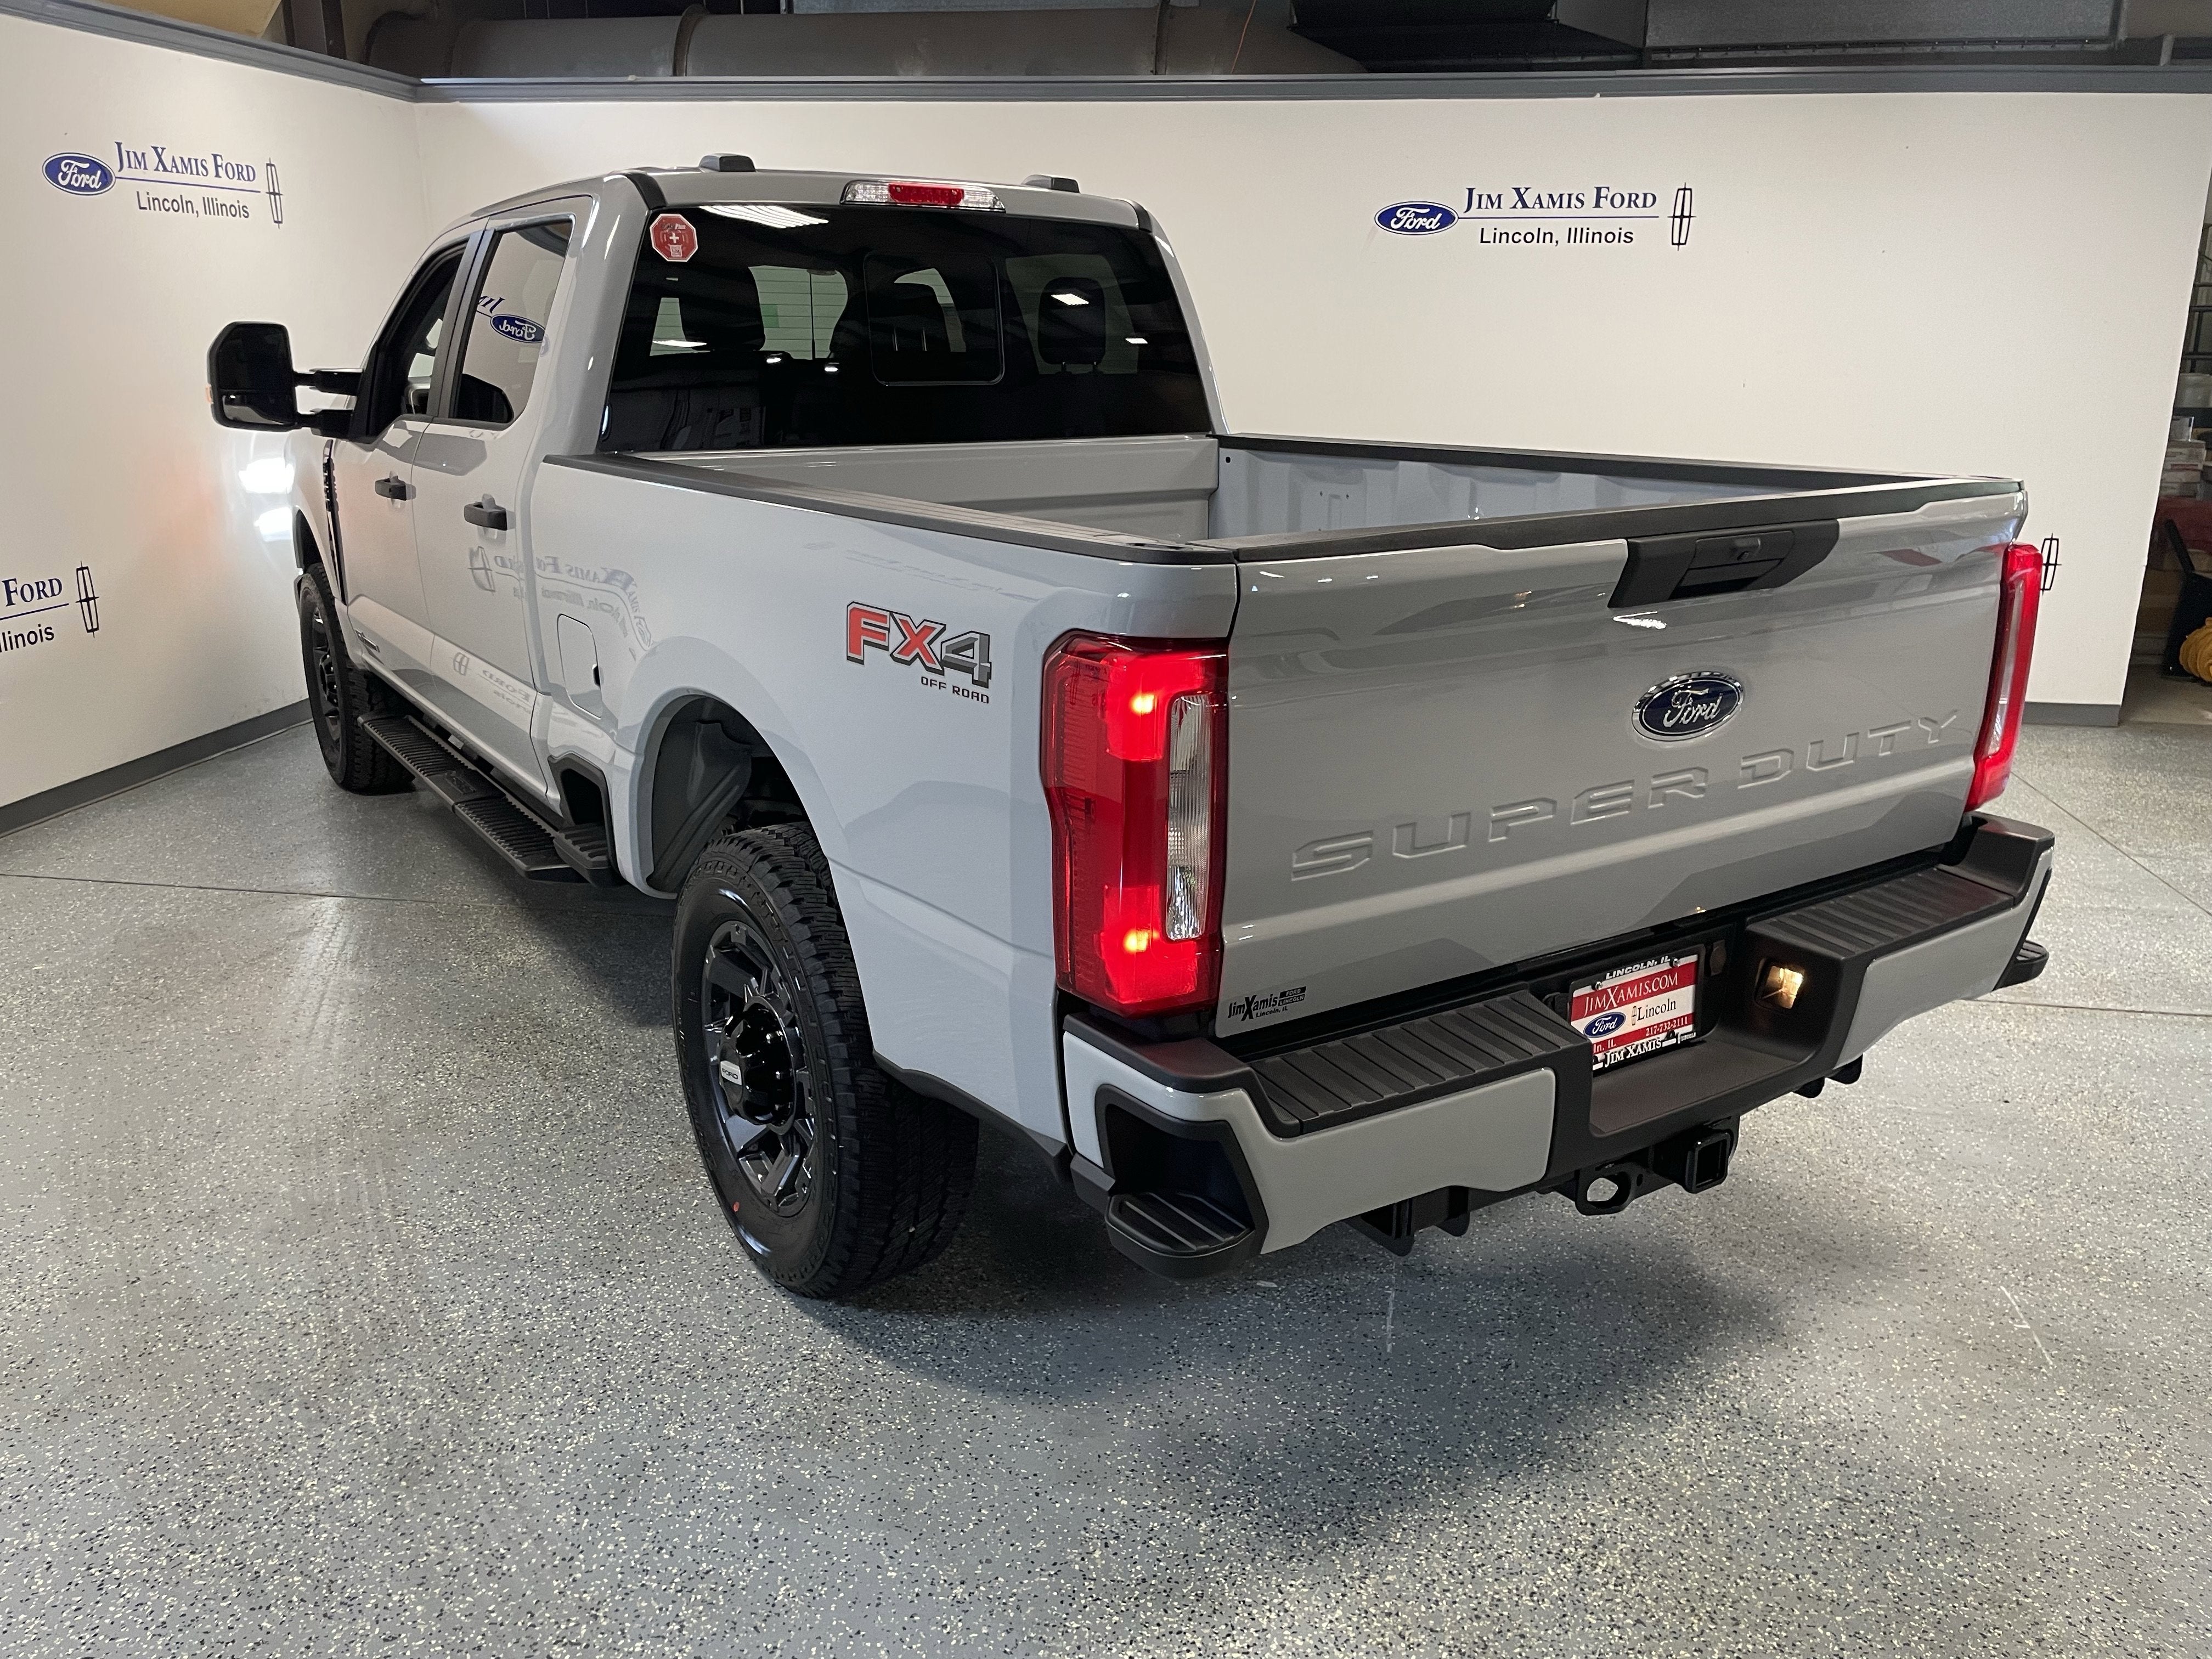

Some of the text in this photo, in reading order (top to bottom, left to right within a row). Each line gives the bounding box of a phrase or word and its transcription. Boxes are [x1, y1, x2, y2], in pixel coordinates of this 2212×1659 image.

[58, 160, 103, 189] Ford
[115, 142, 256, 183] JIM XAMIS FORD
[136, 190, 250, 219] Lincoln, Illinois
[1463, 186, 1657, 214] JIM XAMIS FORD
[1390, 207, 1441, 230] Ford
[1480, 227, 1634, 246] Lincoln, Illinois
[2, 578, 63, 607] FORD
[847, 601, 992, 689] FX4
[921, 676, 989, 704] OFF ROAD
[1663, 688, 1724, 727] Ford
[1291, 708, 1960, 881] SUPER DUTY
[1606, 956, 1671, 980] LINCOLN, IL
[1286, 988, 1301, 996] FORD
[1256, 1008, 1281, 1018] Lincoln,
[1638, 998, 1677, 1021] Lincoln
[1592, 1015, 1616, 1035] Ford
[1646, 1016, 1688, 1036] 217-732-2111
[1605, 1039, 1662, 1068] JIM XAMIS
[1607, 1039, 1616, 1049] IL
